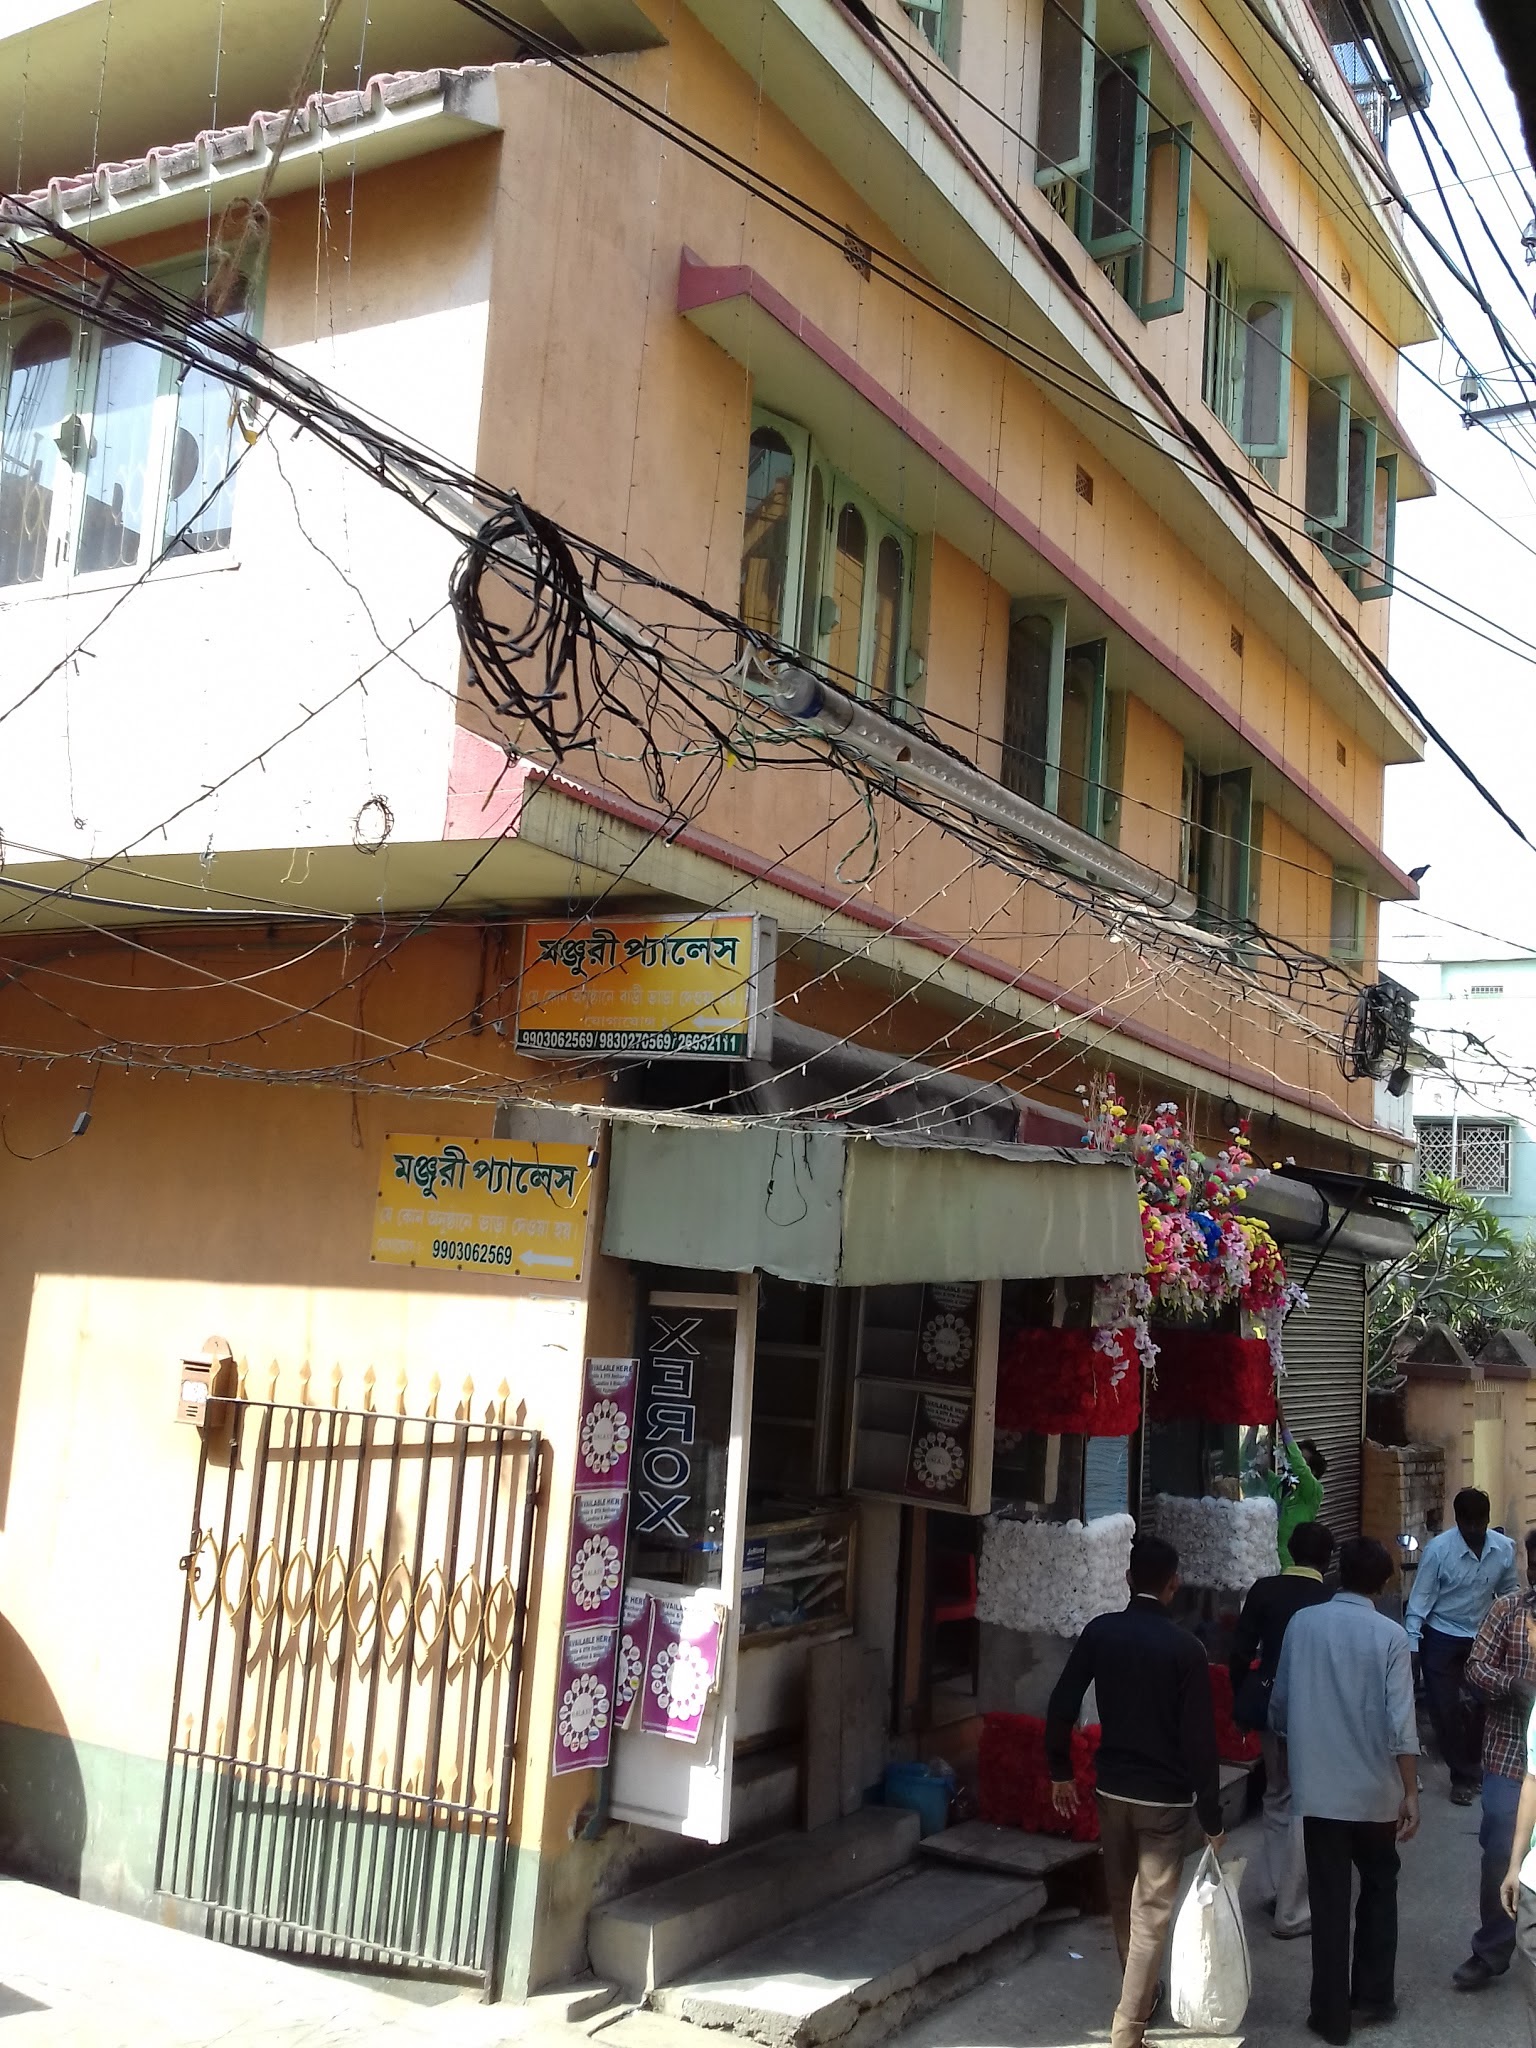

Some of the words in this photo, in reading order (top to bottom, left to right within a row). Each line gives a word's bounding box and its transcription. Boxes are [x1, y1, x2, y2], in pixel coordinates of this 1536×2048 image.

[624, 934, 740, 967] প্যালেস
[393, 1144, 470, 1200] মঞ্জুরী
[472, 1155, 579, 1198] প্যালেস
[432, 1239, 513, 1266] 9903062569
[596, 1635, 612, 1643] HERE
